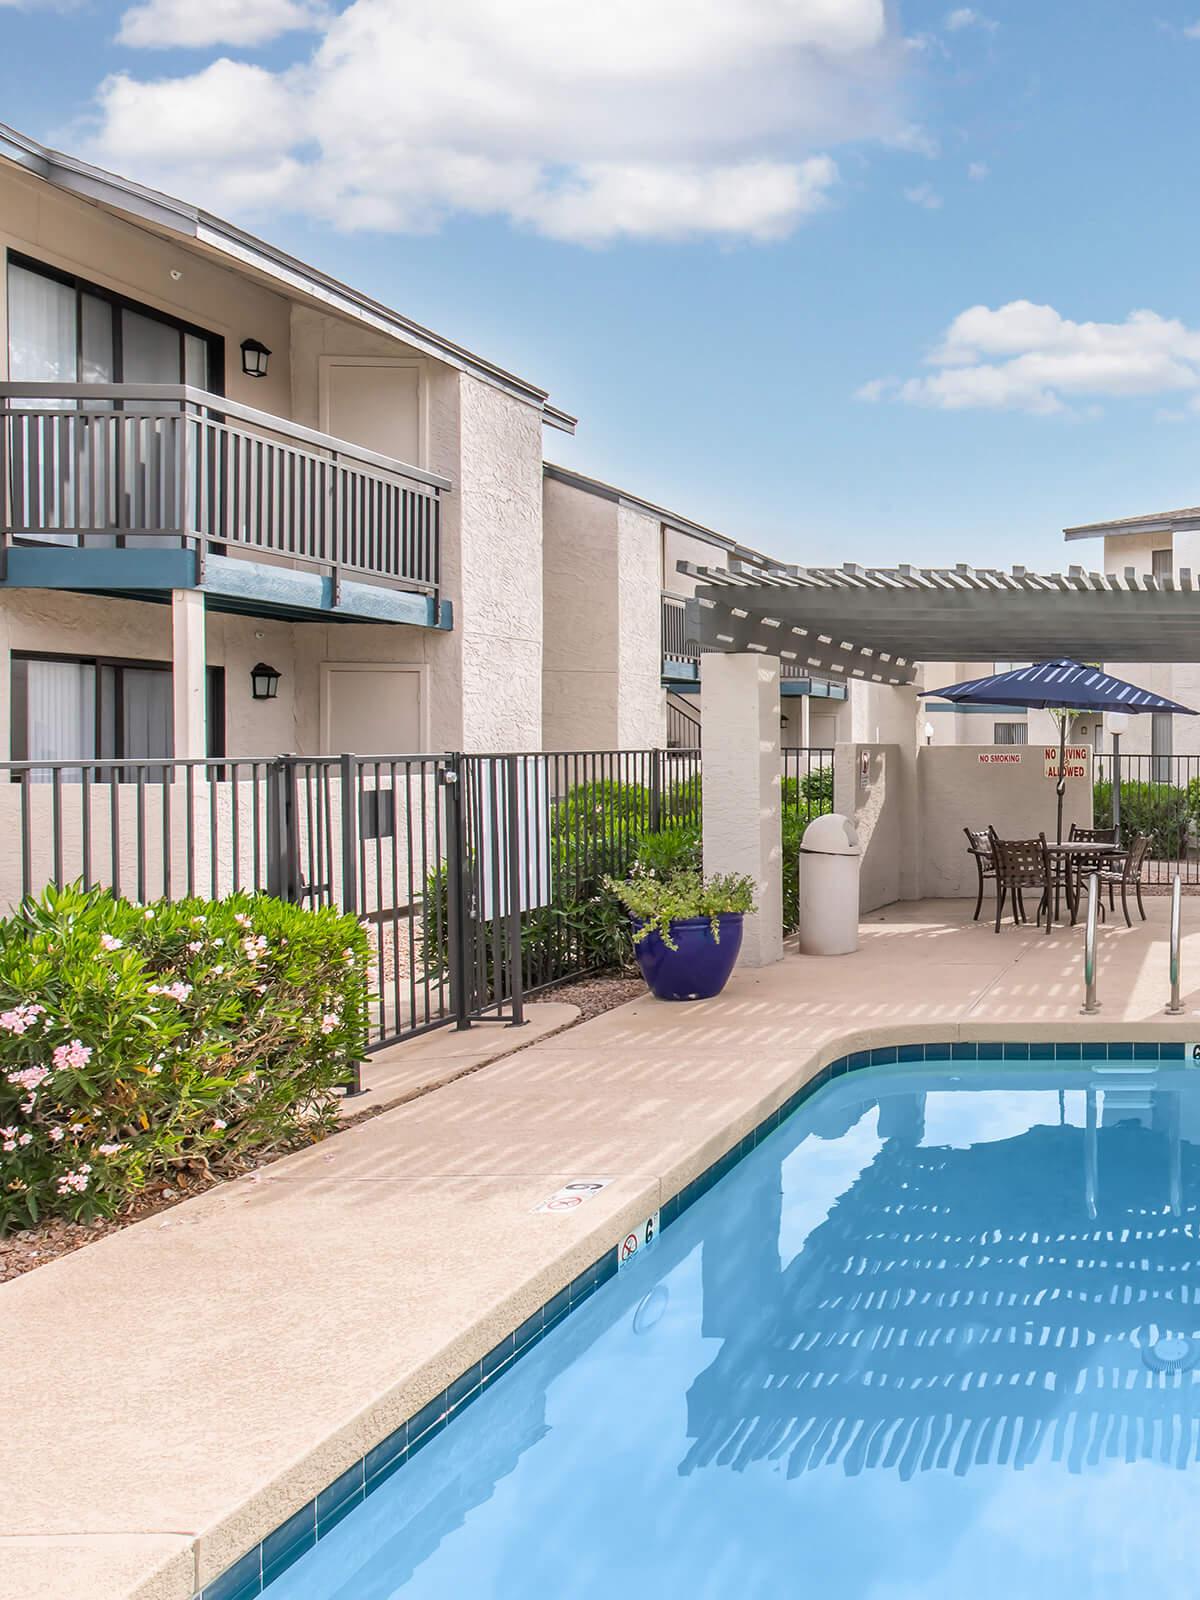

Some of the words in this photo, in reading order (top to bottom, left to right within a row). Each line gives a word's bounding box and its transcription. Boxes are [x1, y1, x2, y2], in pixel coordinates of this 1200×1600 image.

[979, 755, 990, 763] NO
[991, 754, 1020, 763] SMOKING
[1045, 748, 1057, 760] NO
[1060, 748, 1087, 760] IVING
[645, 1218, 653, 1244] 6
